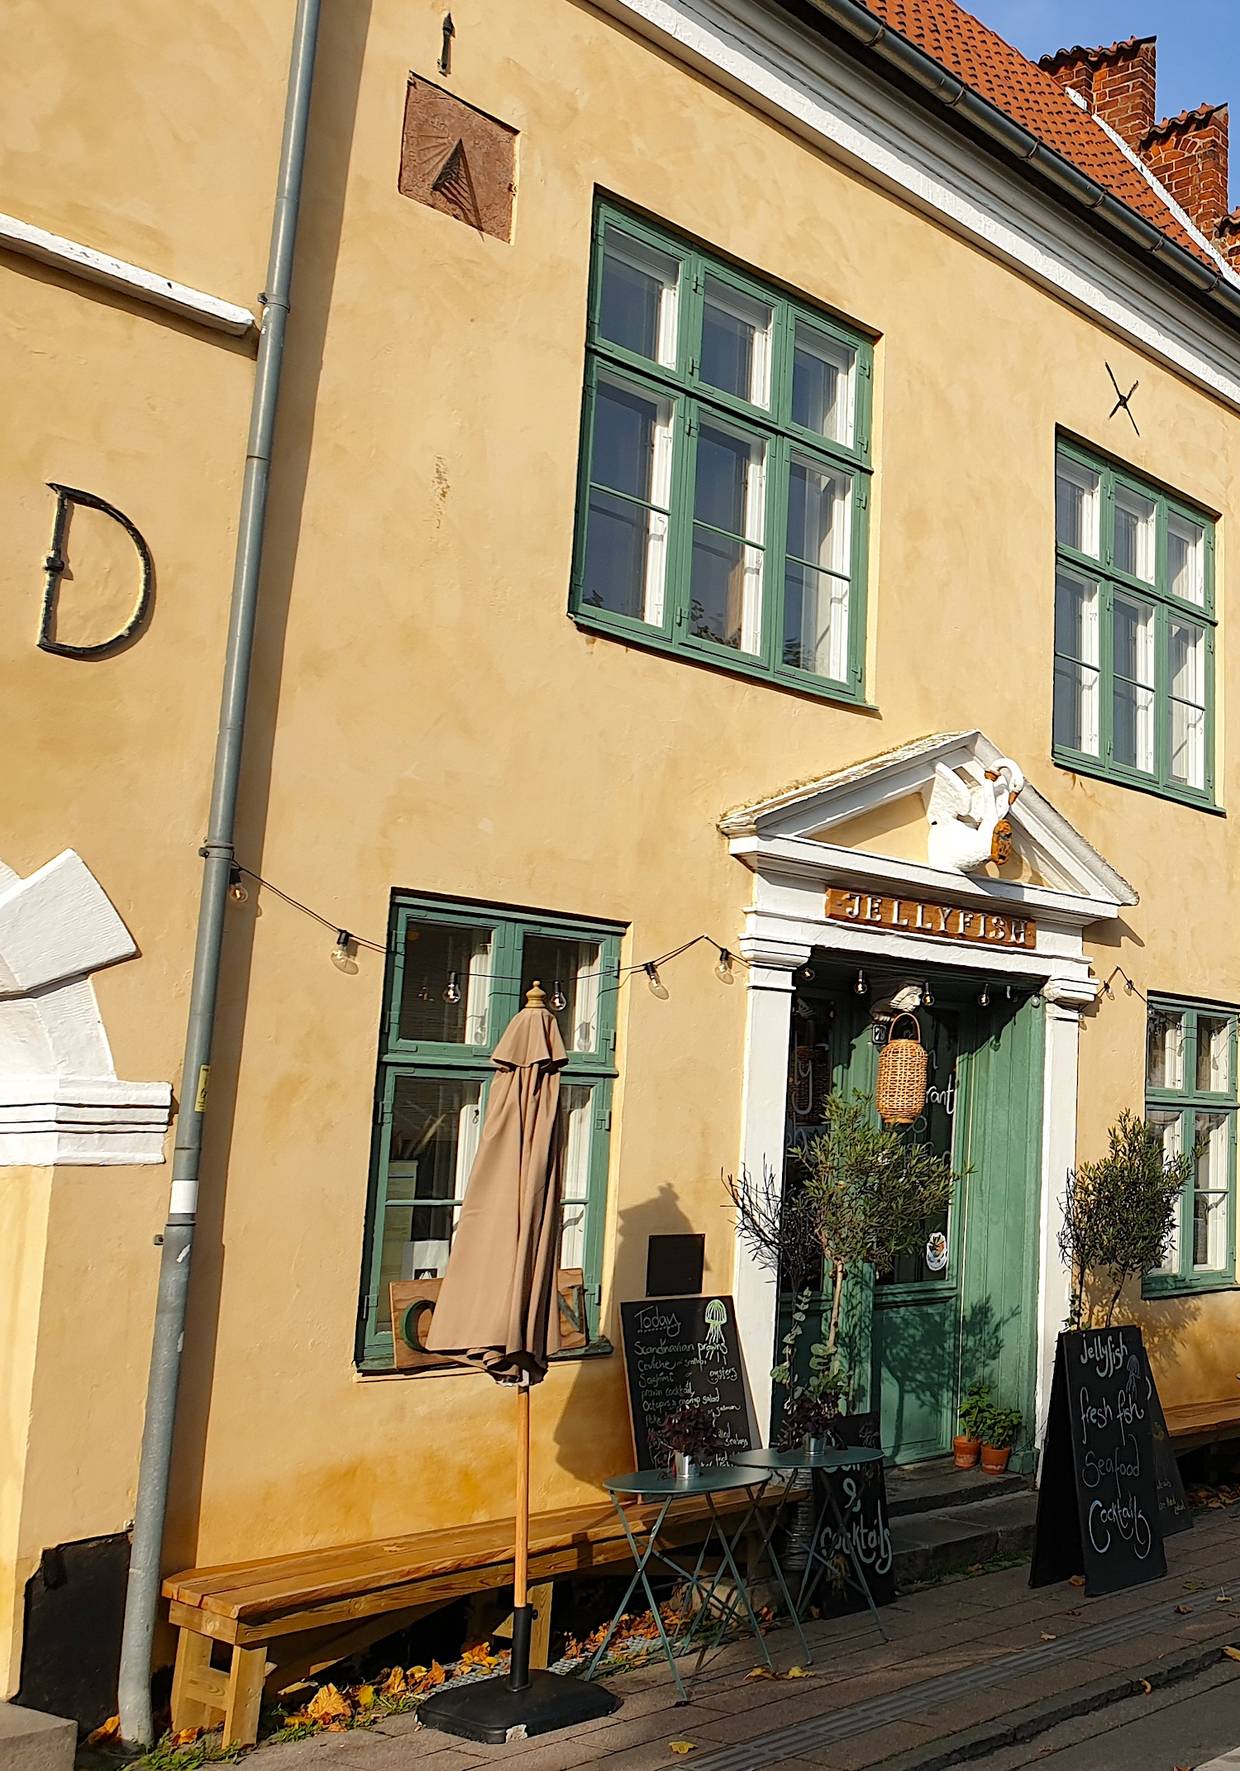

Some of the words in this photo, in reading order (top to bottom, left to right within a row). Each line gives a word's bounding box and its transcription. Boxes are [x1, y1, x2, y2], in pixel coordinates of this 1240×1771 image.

[845, 893, 1027, 944] JELLYFISH
[634, 1305, 681, 1337] Today
[1080, 1386, 1113, 1445] fresh
[1117, 1392, 1145, 1446] fish
[1082, 1433, 1140, 1497] Seafood
[1088, 1494, 1151, 1559] Cocktails
